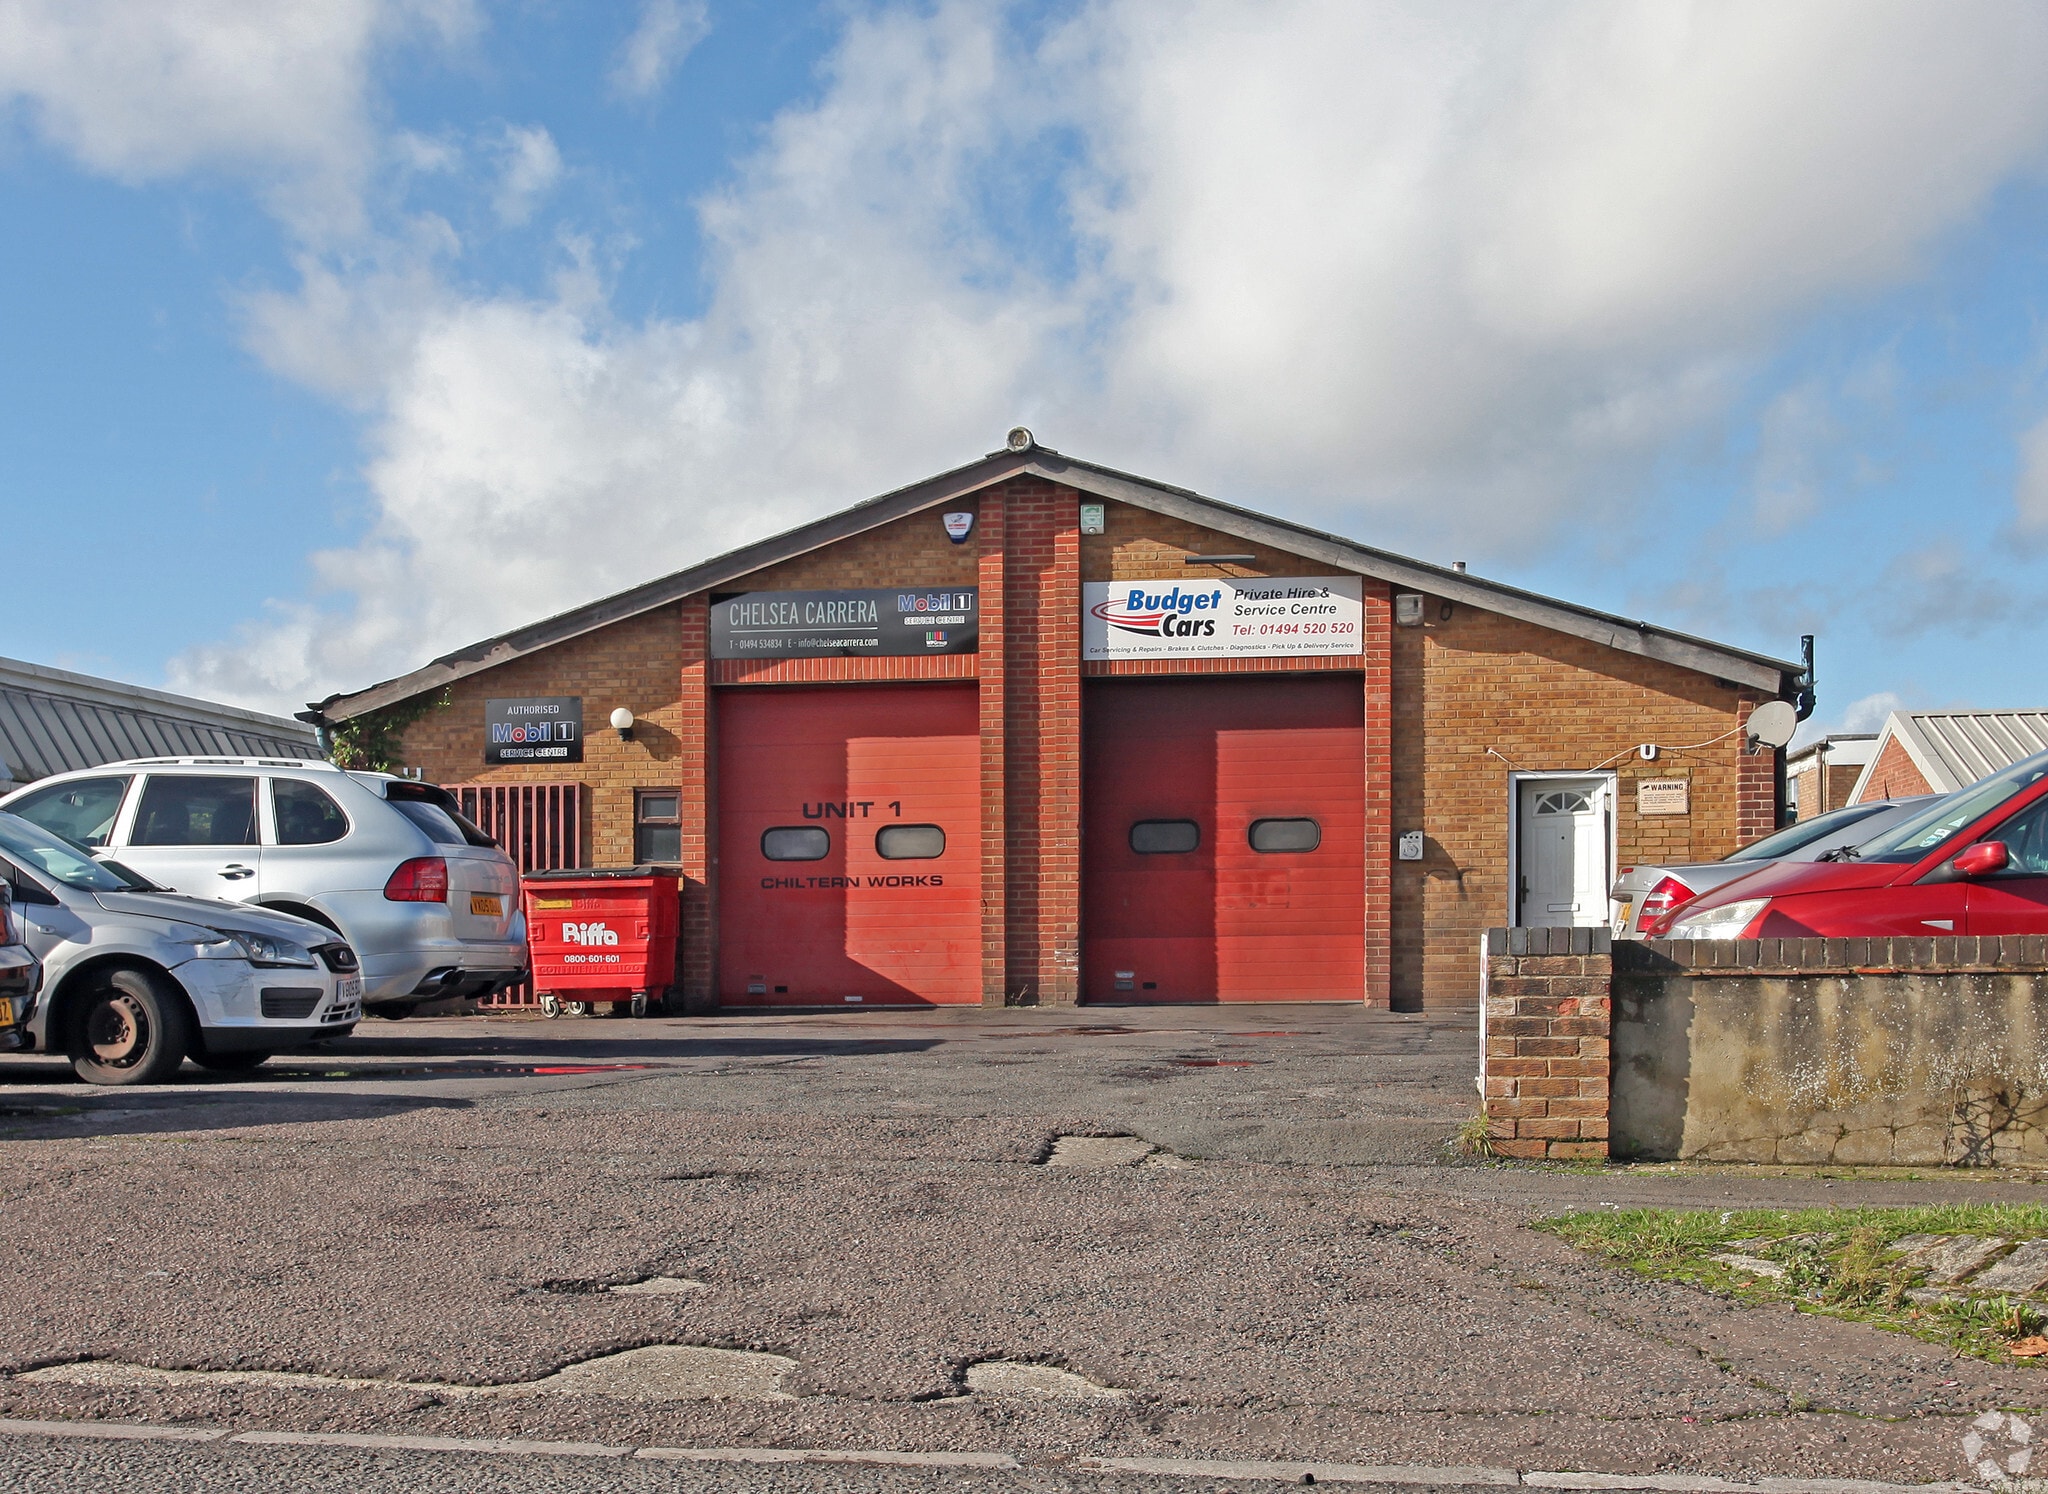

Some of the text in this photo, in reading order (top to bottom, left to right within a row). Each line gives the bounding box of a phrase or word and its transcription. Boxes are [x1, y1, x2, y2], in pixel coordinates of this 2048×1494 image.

[1234, 587, 1330, 600] Private Hire &
[898, 594, 950, 612] Mobil
[1127, 587, 1221, 614] Budget
[730, 600, 878, 626] CHELSEA CARRERA
[1234, 603, 1337, 616] Service Centre
[904, 615, 965, 626] SERVICE CENTRE
[1163, 614, 1215, 637] Cars
[1233, 622, 1354, 635] Tel: 01494 520 520
[730, 640, 733, 649] T
[740, 639, 757, 650] 01494
[760, 639, 782, 649] 534834
[788, 639, 792, 648] E
[798, 638, 879, 648] info@chelseacarrera.com
[1102, 646, 1131, 654] Servicing
[1304, 642, 1329, 650] Delivery
[507, 705, 560, 715] AUTHORISED
[492, 722, 551, 743] Mobil
[500, 747, 568, 758] SERVICE CENTRE
[1651, 783, 1684, 791] WARNING
[803, 801, 901, 819] UNIT 1
[761, 875, 943, 889] CHILTERN WORKS
[562, 922, 619, 946] Biffa
[541, 965, 613, 974] CONTINENTAL
